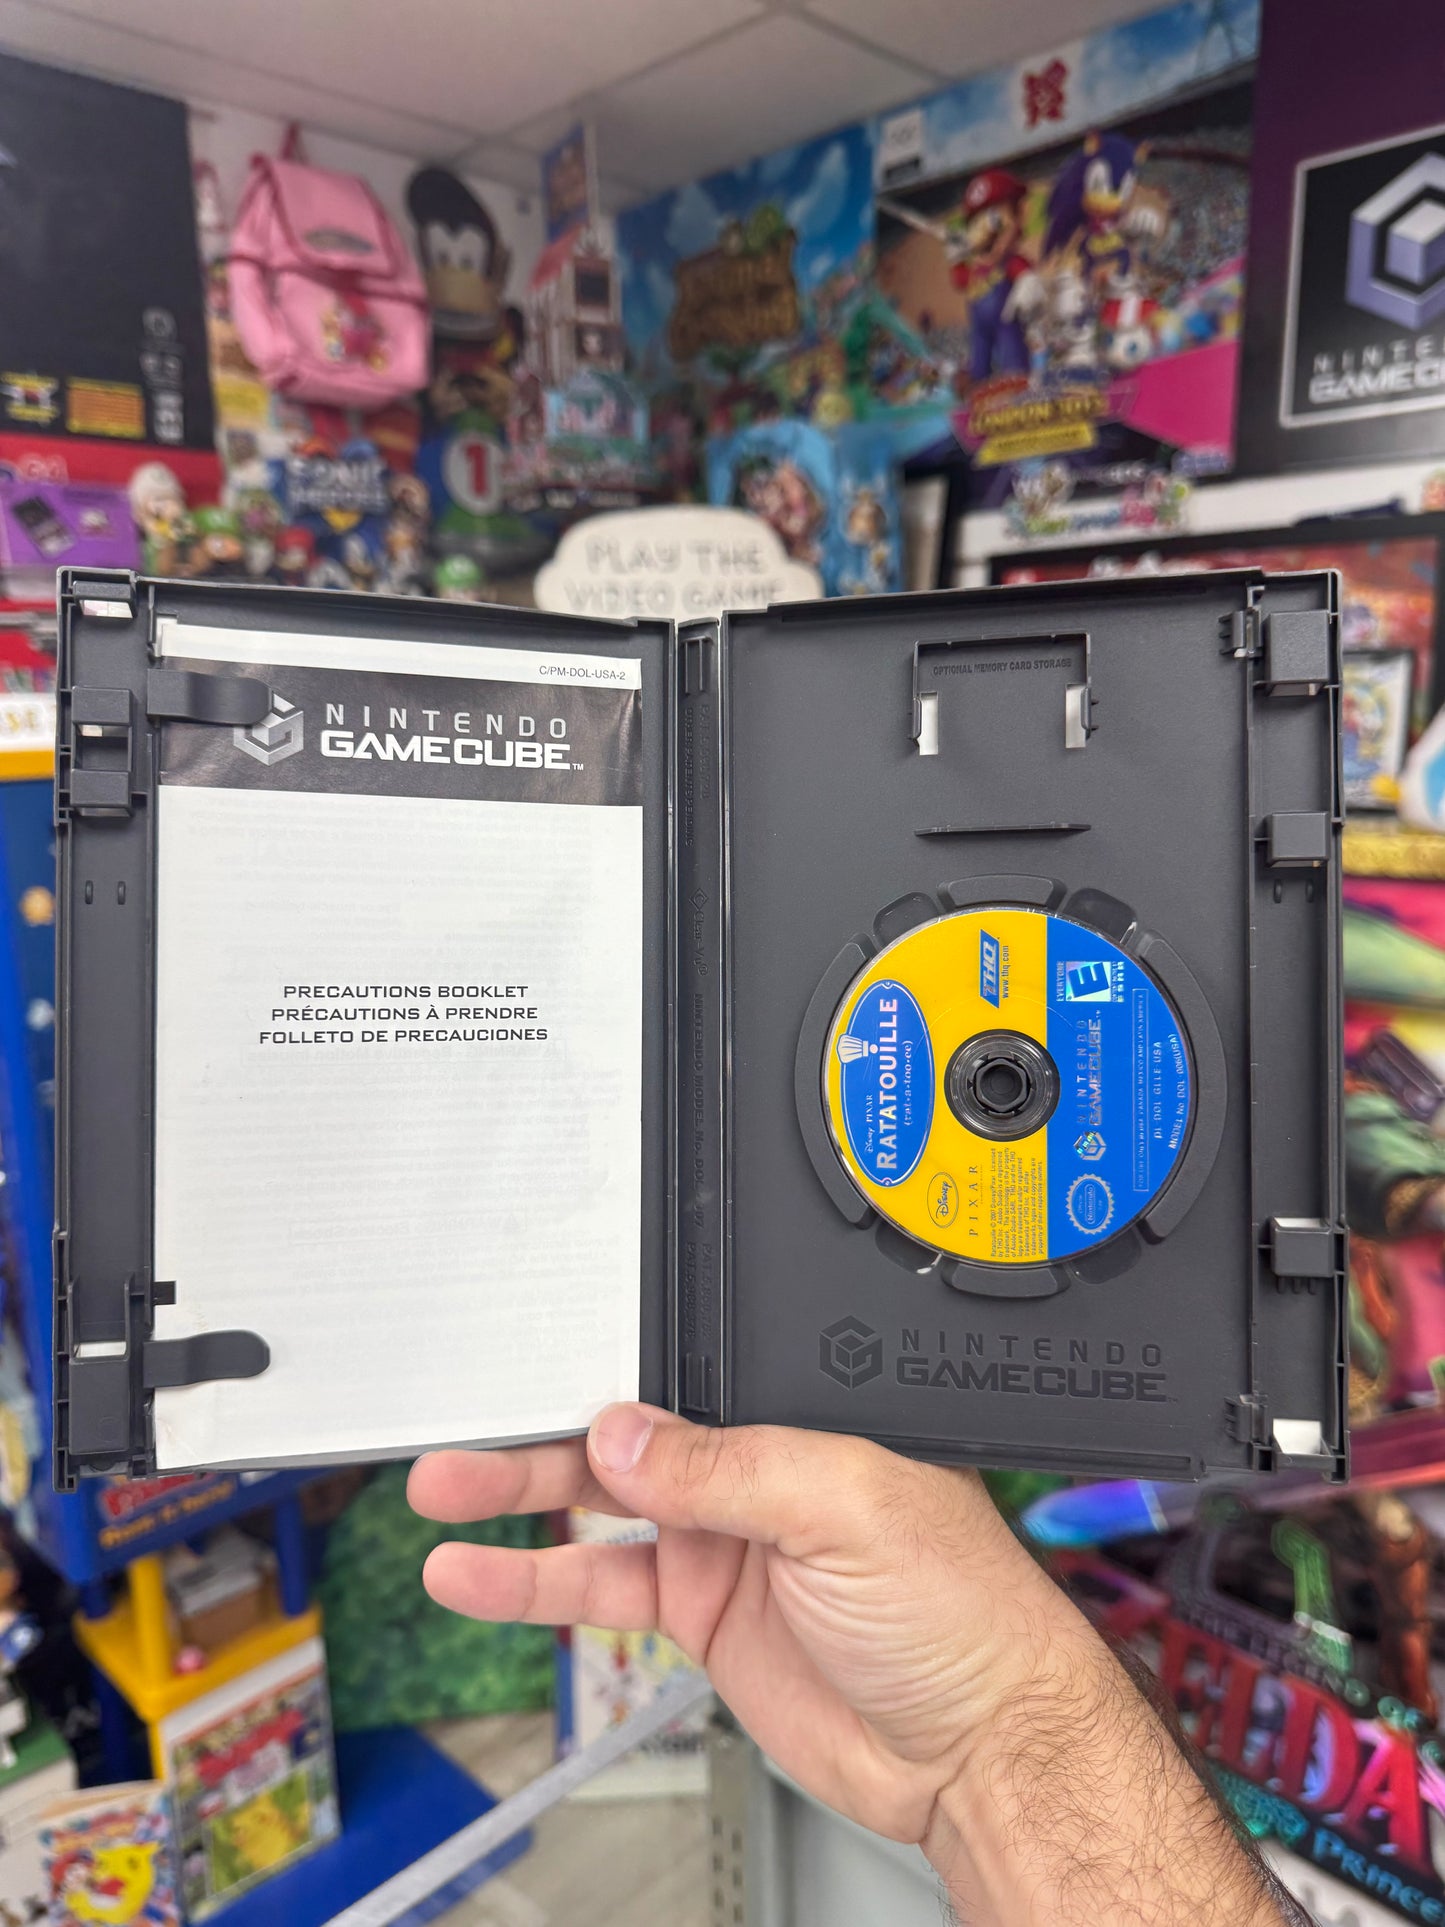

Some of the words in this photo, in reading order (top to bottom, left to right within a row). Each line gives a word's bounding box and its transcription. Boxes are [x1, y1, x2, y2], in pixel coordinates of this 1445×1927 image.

[1313, 334, 1445, 373] NINTE
[1308, 352, 1445, 404] GAMEC
[539, 665, 626, 681] C/PM-DOL-USA-2
[933, 664, 972, 676] OPTIONAL
[974, 662, 1008, 673] MEMORY
[1009, 660, 1032, 671] CARD
[1033, 658, 1072, 669] STORAGE
[326, 703, 567, 739] NINTENDO
[983, 941, 996, 997] THQ
[283, 986, 431, 998] PRECAUTIONS
[438, 985, 529, 998] BOOKLET
[271, 1005, 420, 1021] PRÉCAUTIONS
[426, 1005, 439, 1020] À
[445, 1007, 538, 1019] PRENDRE
[259, 1031, 354, 1044] FOLLETO
[361, 1030, 388, 1042] DE
[394, 1028, 548, 1042] PRECAUCIONES
[877, 999, 897, 1169] RATATOUILLE
[1076, 1019, 1088, 1123] NINTENDO
[936, 1181, 952, 1219] Disney
[968, 1165, 978, 1237] PIXAR
[902, 1328, 1162, 1367] NINTENDO
